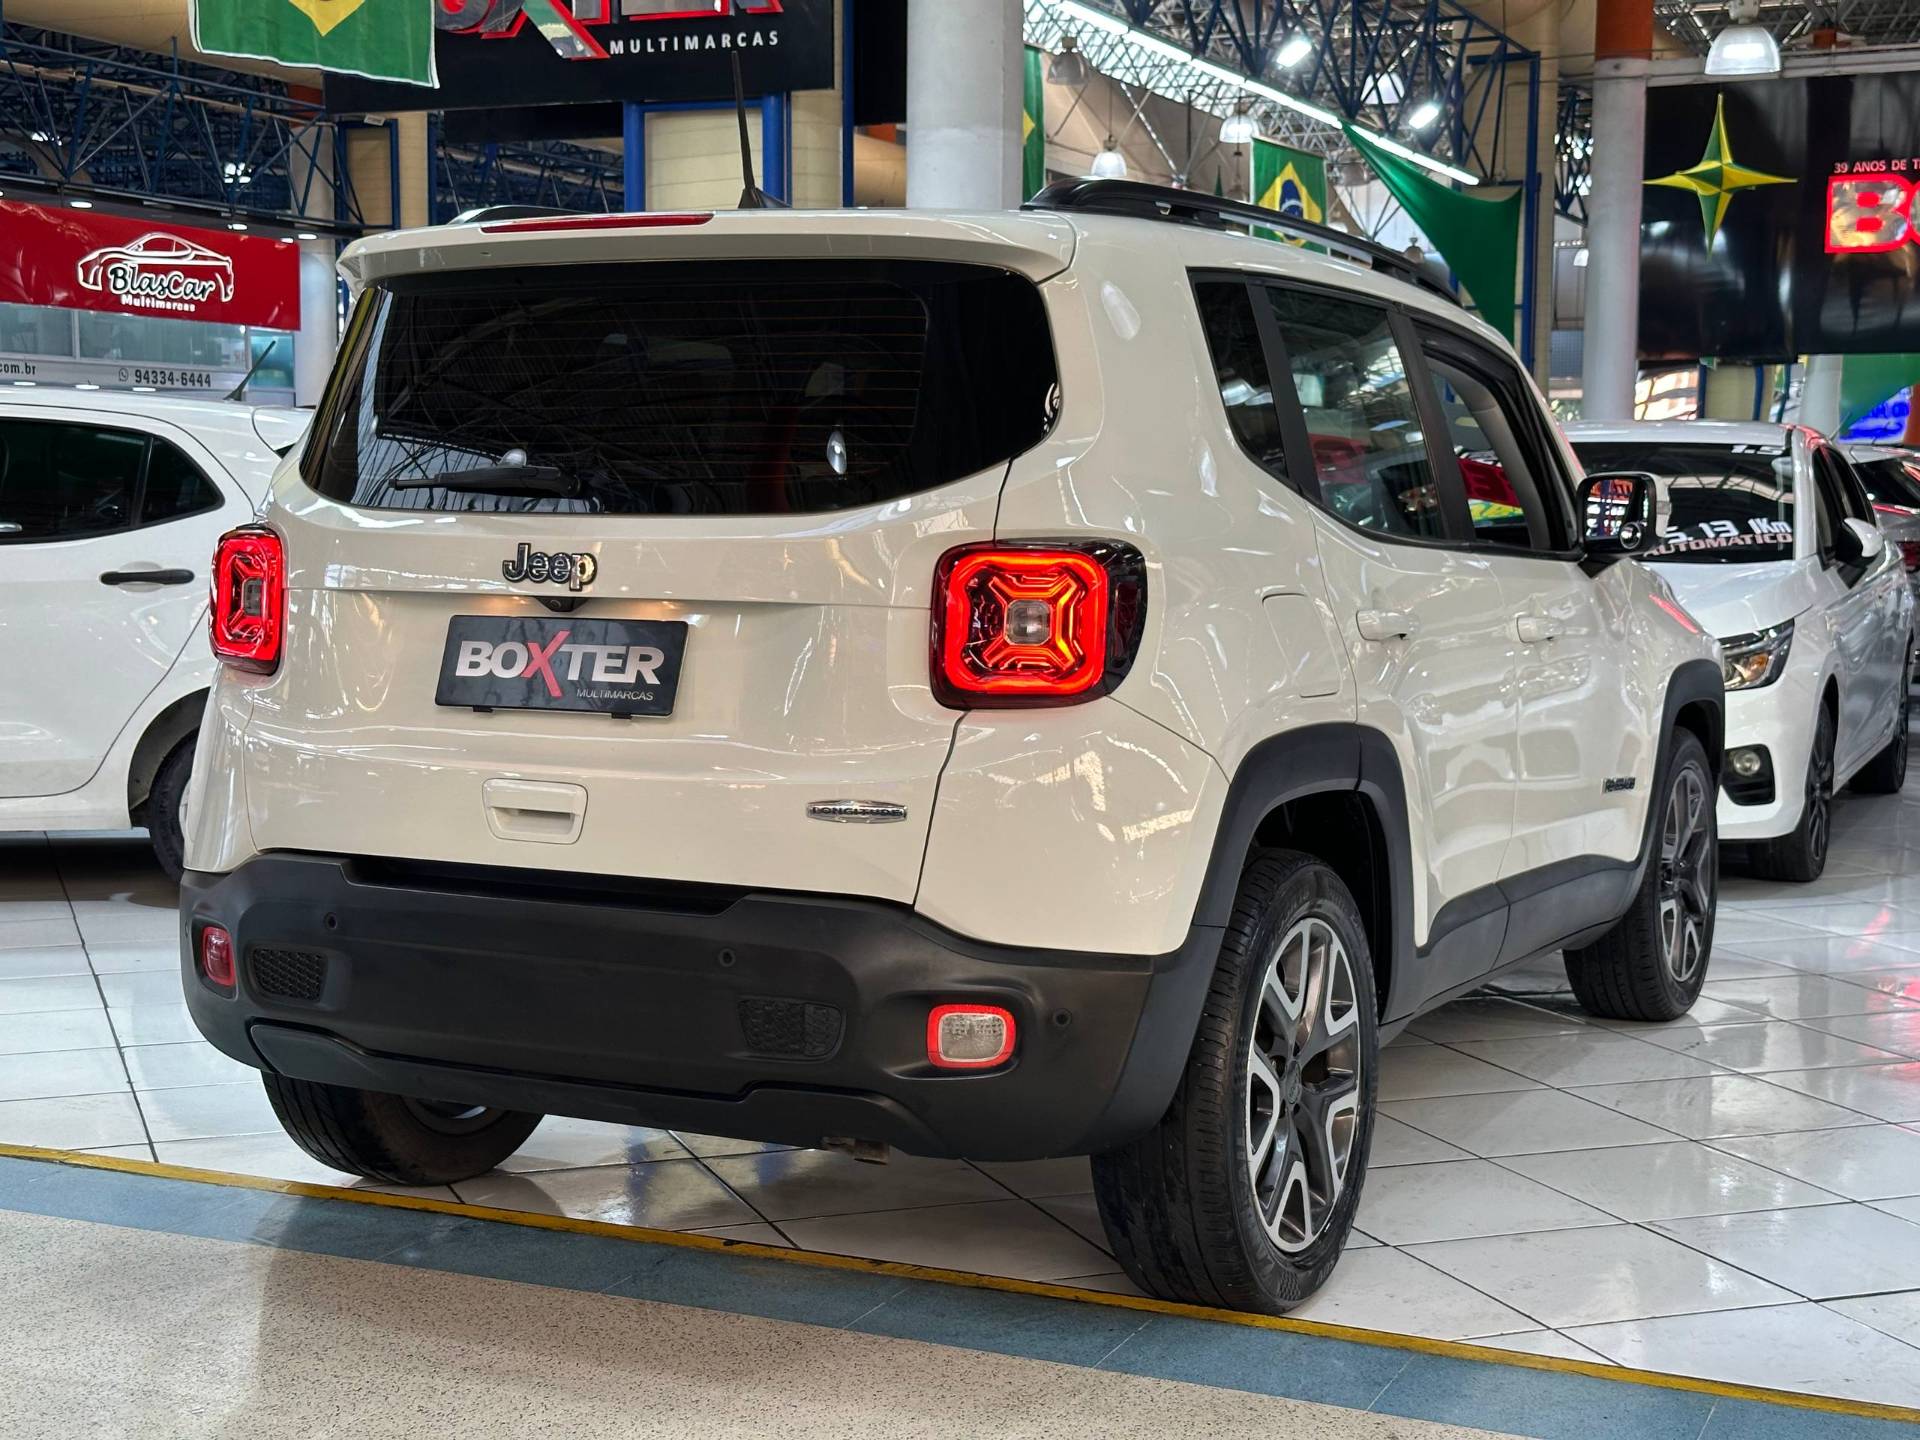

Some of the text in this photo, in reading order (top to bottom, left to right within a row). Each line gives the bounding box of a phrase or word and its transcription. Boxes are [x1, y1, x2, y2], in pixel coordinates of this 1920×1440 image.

[610, 30, 780, 55] MULTIMARCAS
[1833, 162, 1848, 173] 39
[1853, 160, 1886, 173] ANOS
[1891, 159, 1907, 171] DE
[1824, 173, 1920, 254] B
[108, 261, 217, 303] BlasCar
[121, 294, 197, 312] Multimarcas
[134, 368, 212, 388] 94334-6444
[502, 542, 598, 592] Jeep
[455, 630, 665, 698] BOXTER
[576, 687, 654, 701] MULTIMARCAS
